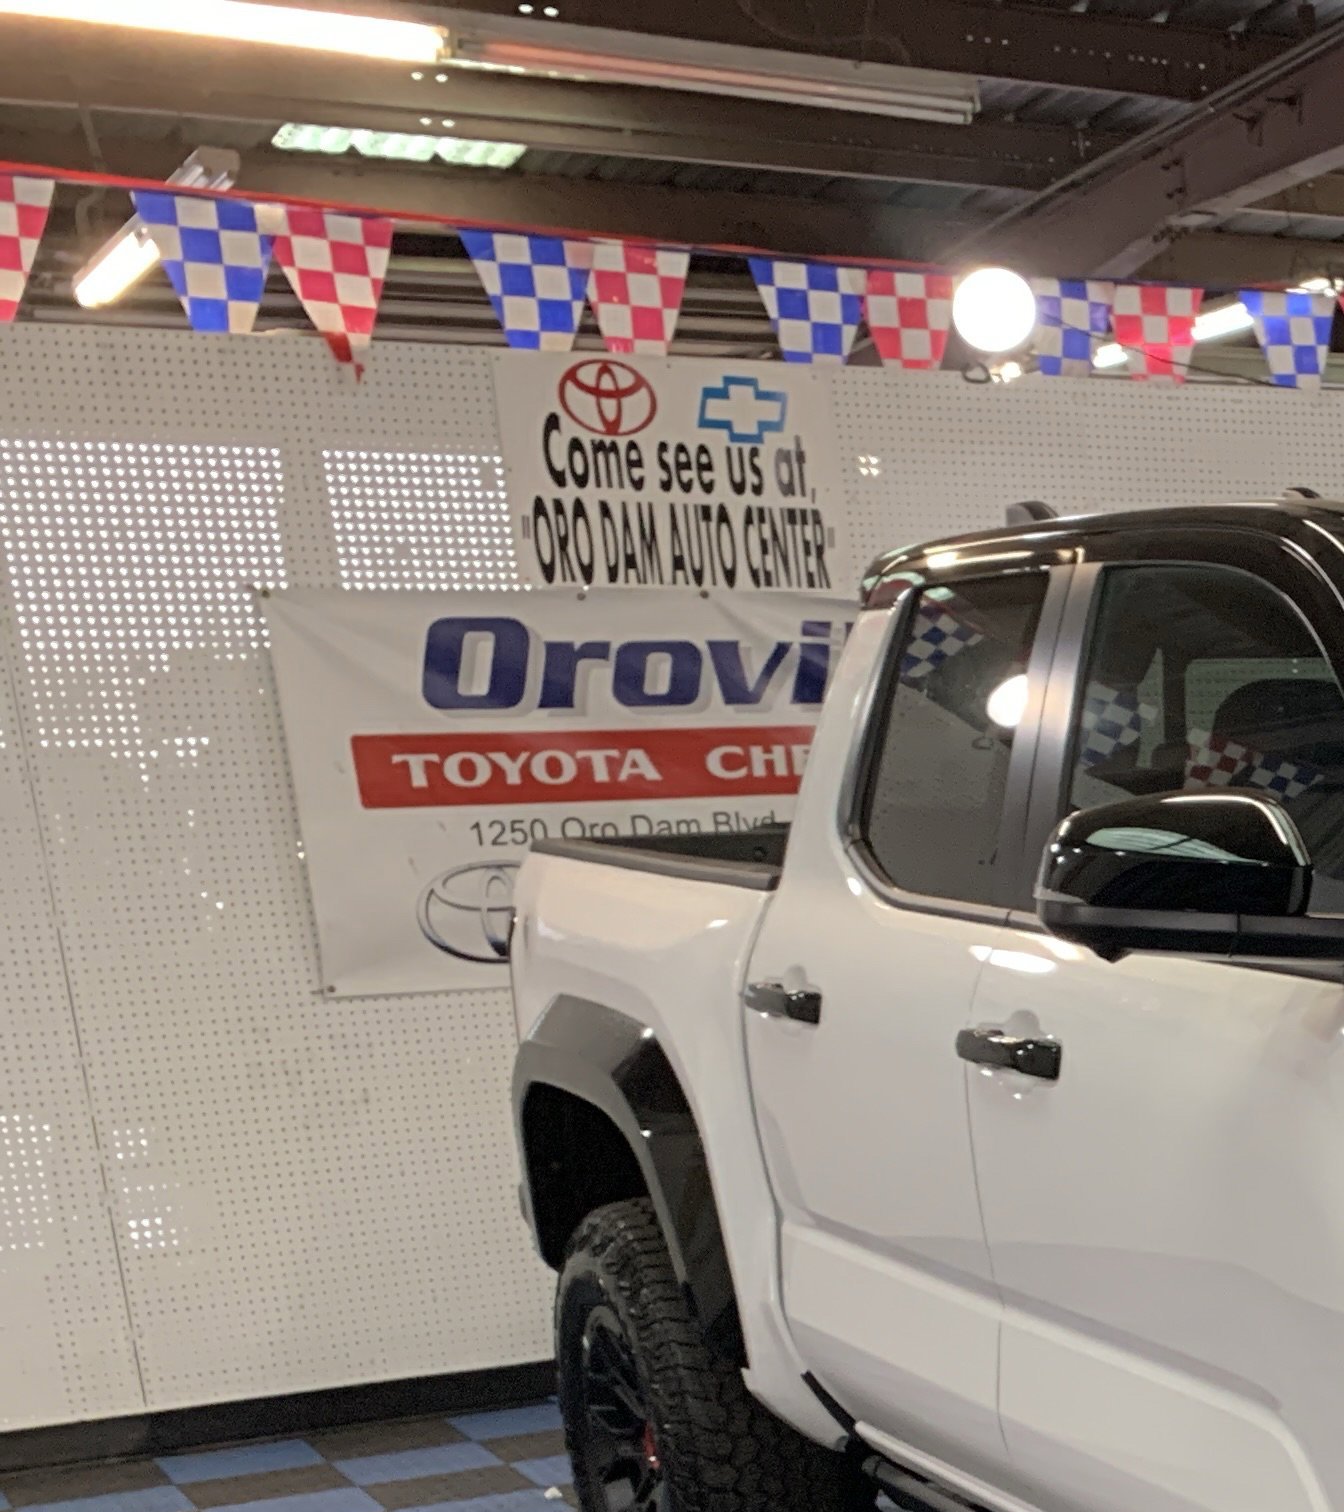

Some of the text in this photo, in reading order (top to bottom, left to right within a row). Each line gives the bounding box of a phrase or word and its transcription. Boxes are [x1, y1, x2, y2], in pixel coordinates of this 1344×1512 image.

[543, 412, 646, 491] Come
[656, 440, 716, 494] see
[725, 445, 764, 496] us
[600, 499, 664, 586] DAM
[669, 502, 738, 588] AUTO
[422, 616, 854, 711] Orovi
[391, 748, 662, 789] TOYOTA
[470, 817, 549, 847] 1250
[561, 816, 617, 839] Oro
[630, 814, 701, 838] Dam
